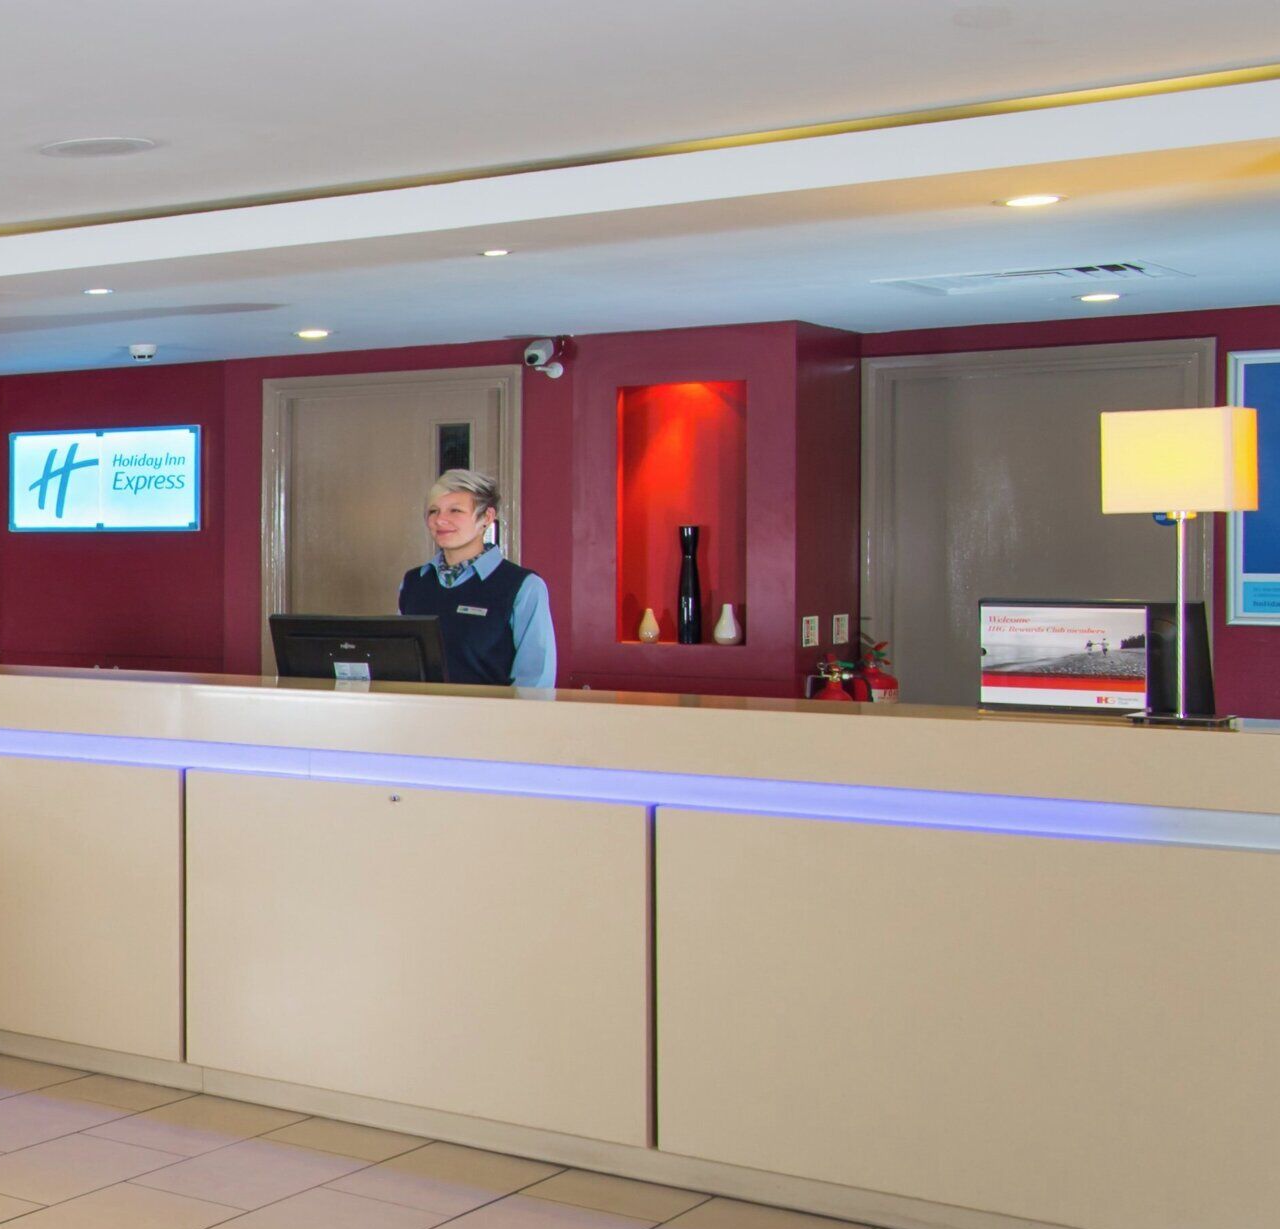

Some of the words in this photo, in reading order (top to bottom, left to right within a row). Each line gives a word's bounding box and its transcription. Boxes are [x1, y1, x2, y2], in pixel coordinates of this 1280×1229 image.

[112, 453, 162, 469] Holiday
[165, 452, 186, 466] Inn
[112, 471, 186, 495] Express
[988, 616, 1031, 624] Welcome
[1096, 696, 1117, 704] IHG
